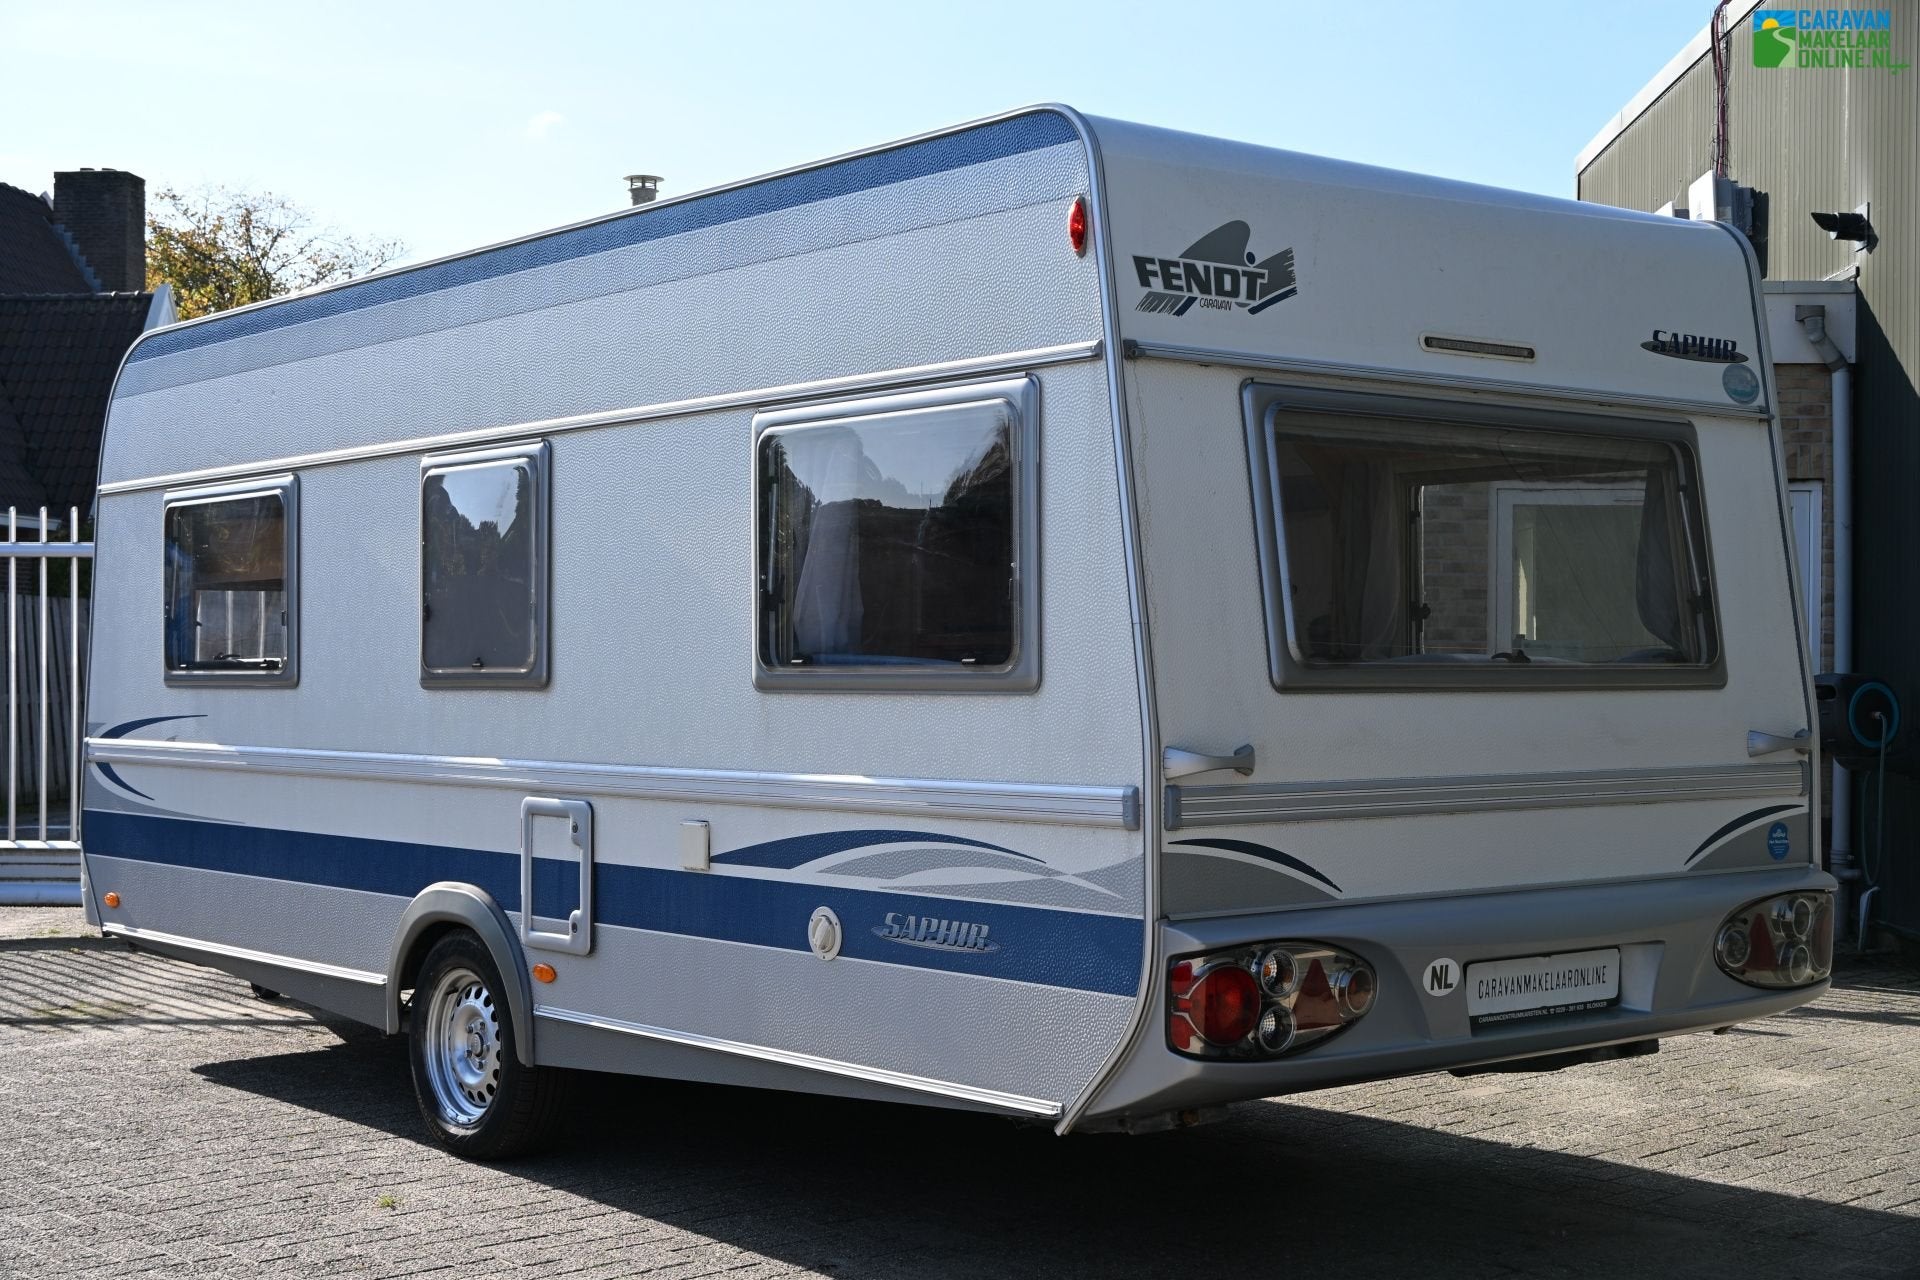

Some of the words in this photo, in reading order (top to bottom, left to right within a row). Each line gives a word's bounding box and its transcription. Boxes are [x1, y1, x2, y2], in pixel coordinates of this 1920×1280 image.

[1132, 255, 1266, 301] FENDT
[1200, 297, 1232, 311] CARAVAN
[1652, 329, 1737, 361] SAPHIR
[881, 912, 990, 950] SAPHIR
[1430, 964, 1454, 991] NL
[1478, 965, 1607, 1000] CARAVANMAKELAARONLINE
